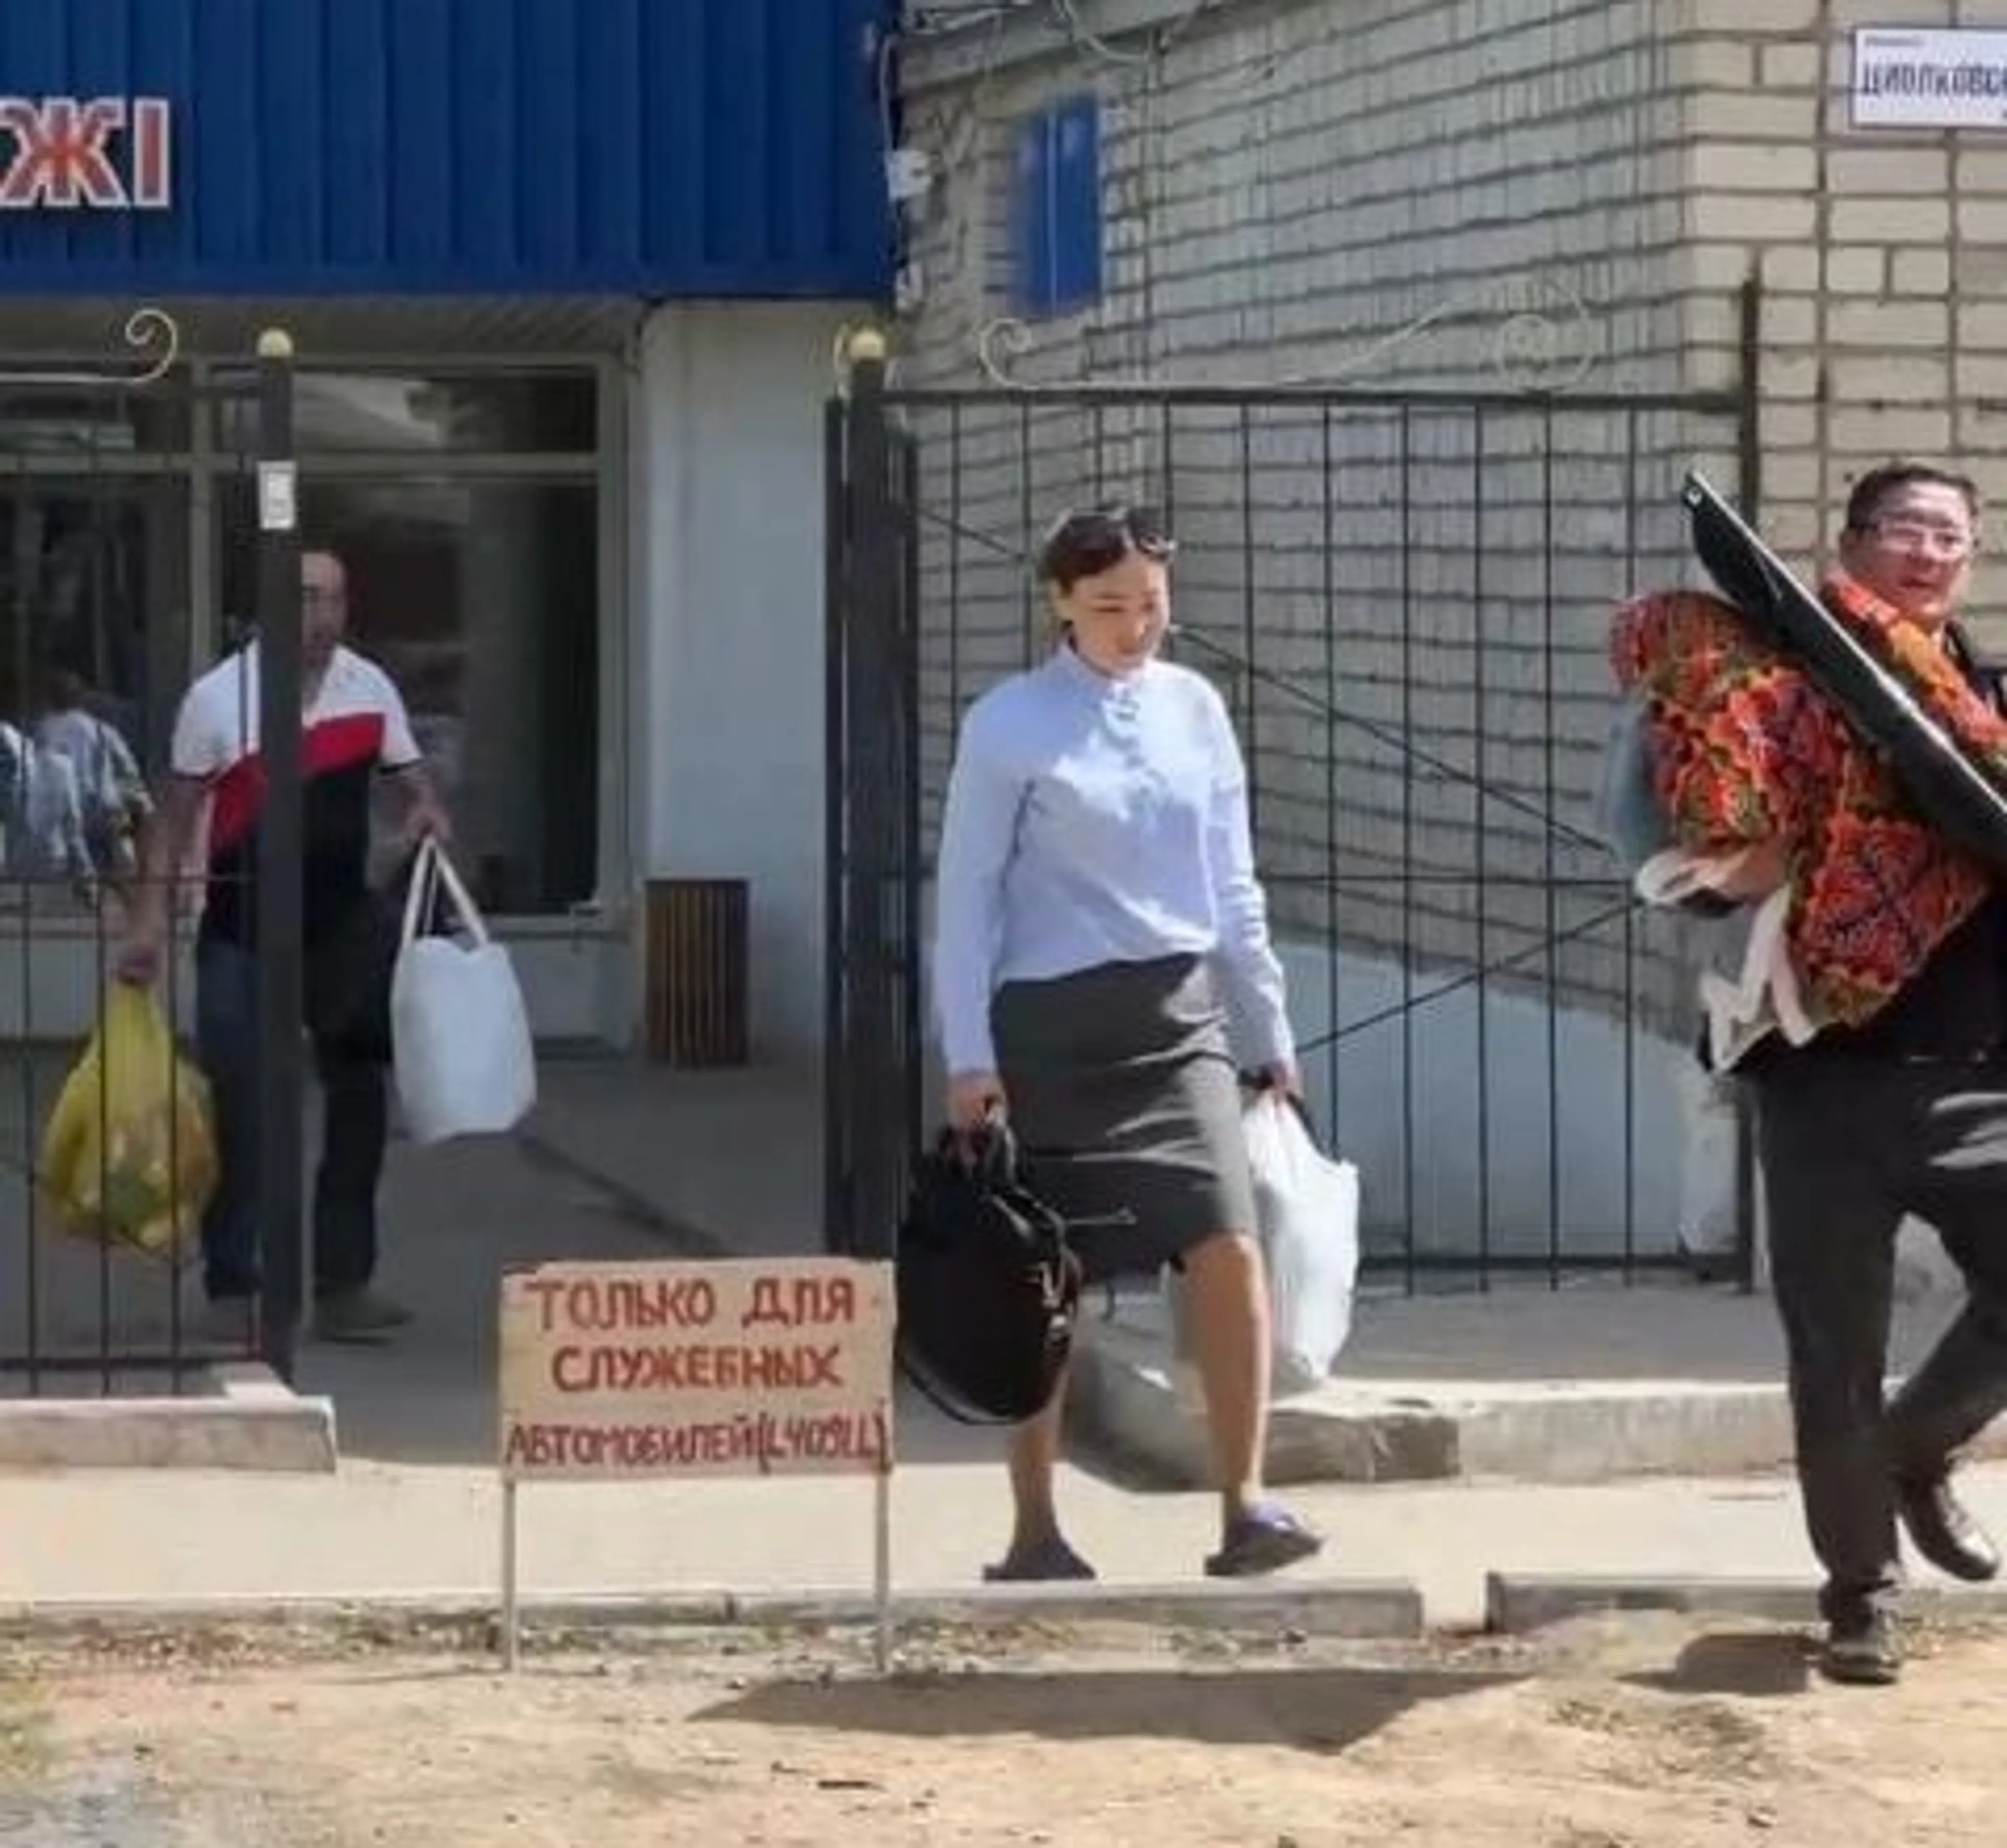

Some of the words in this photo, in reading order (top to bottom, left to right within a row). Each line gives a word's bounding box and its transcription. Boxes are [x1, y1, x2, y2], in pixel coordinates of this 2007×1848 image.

[524, 1277, 717, 1331] ТОЛЬКО
[740, 1276, 855, 1329] ДЛЯ
[551, 1344, 843, 1393] СЛУЖЕБНЫХ
